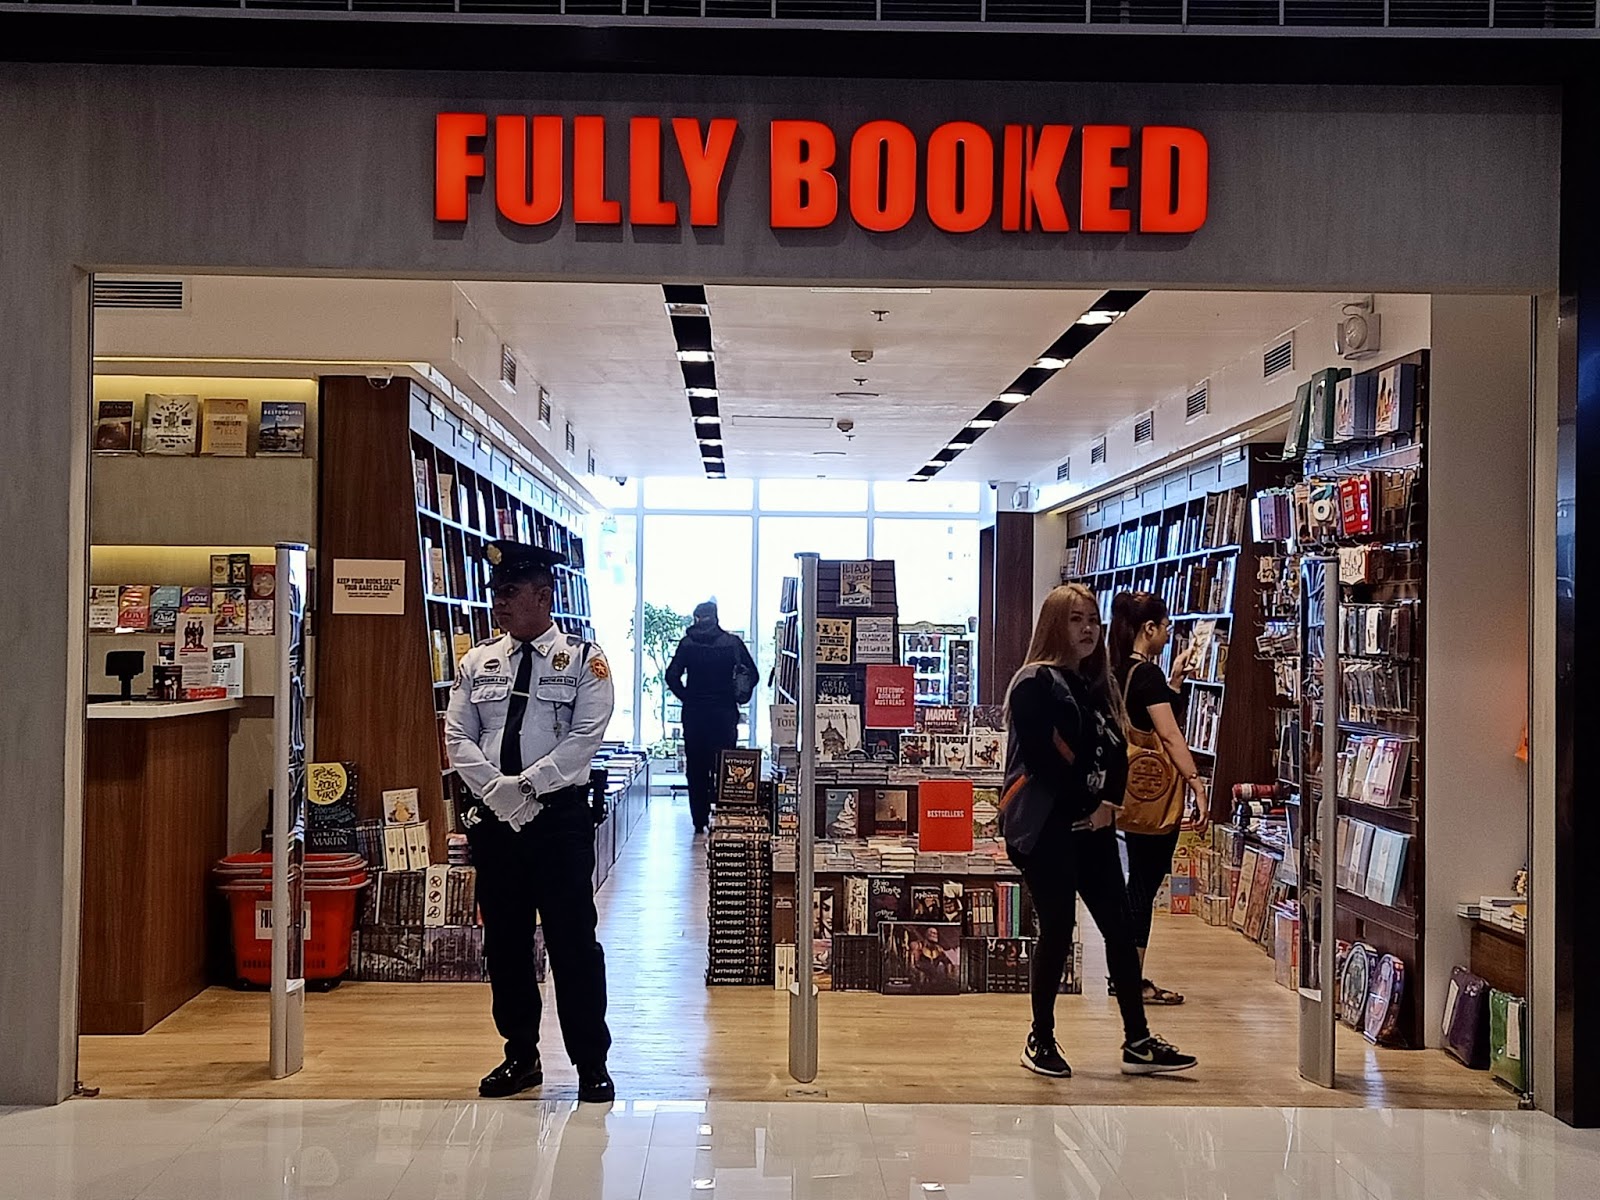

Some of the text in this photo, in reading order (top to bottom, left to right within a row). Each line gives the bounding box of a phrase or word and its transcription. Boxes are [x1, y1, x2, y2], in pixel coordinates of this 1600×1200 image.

[434, 113, 1209, 234] FULLY BOOKED
[842, 563, 870, 574] ILIAD
[154, 611, 175, 622] Dad
[925, 708, 958, 721] MARVEL
[927, 810, 965, 818] BESTSELLERS
[312, 837, 348, 846] MARTIN
[1173, 899, 1187, 912] W
